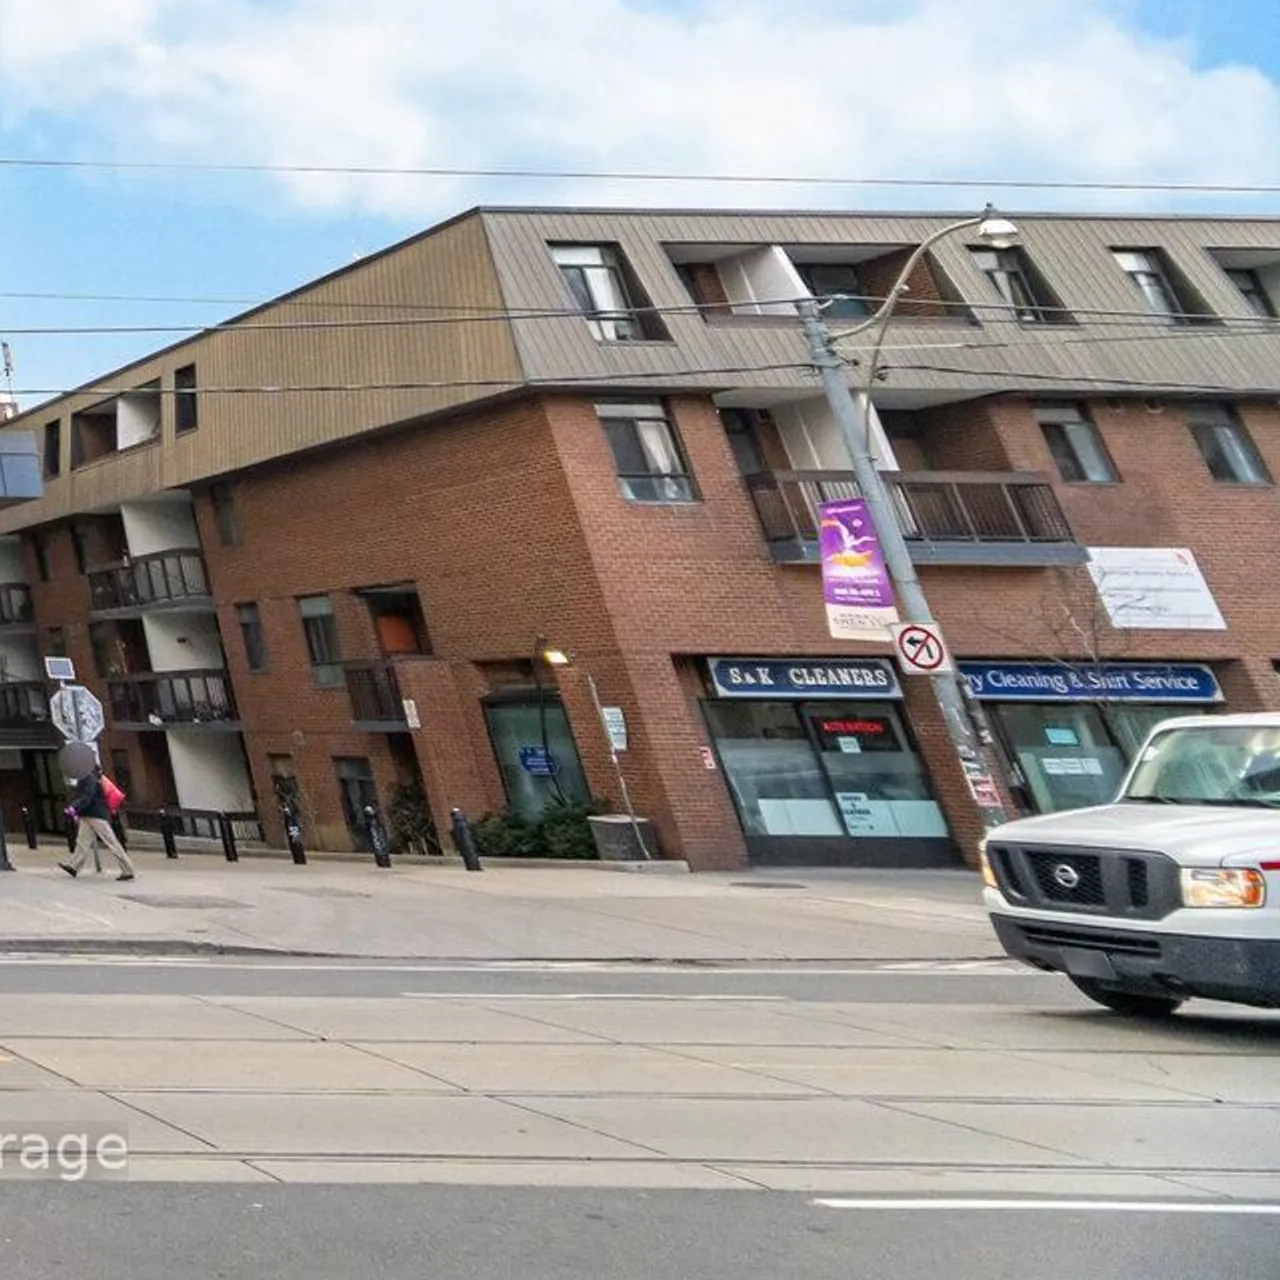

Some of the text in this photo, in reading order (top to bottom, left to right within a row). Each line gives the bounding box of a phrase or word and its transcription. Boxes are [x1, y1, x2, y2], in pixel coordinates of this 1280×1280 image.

[790, 667, 888, 688] CLEANERS
[989, 669, 1070, 693] Cleaning
[1132, 671, 1201, 691] Service
